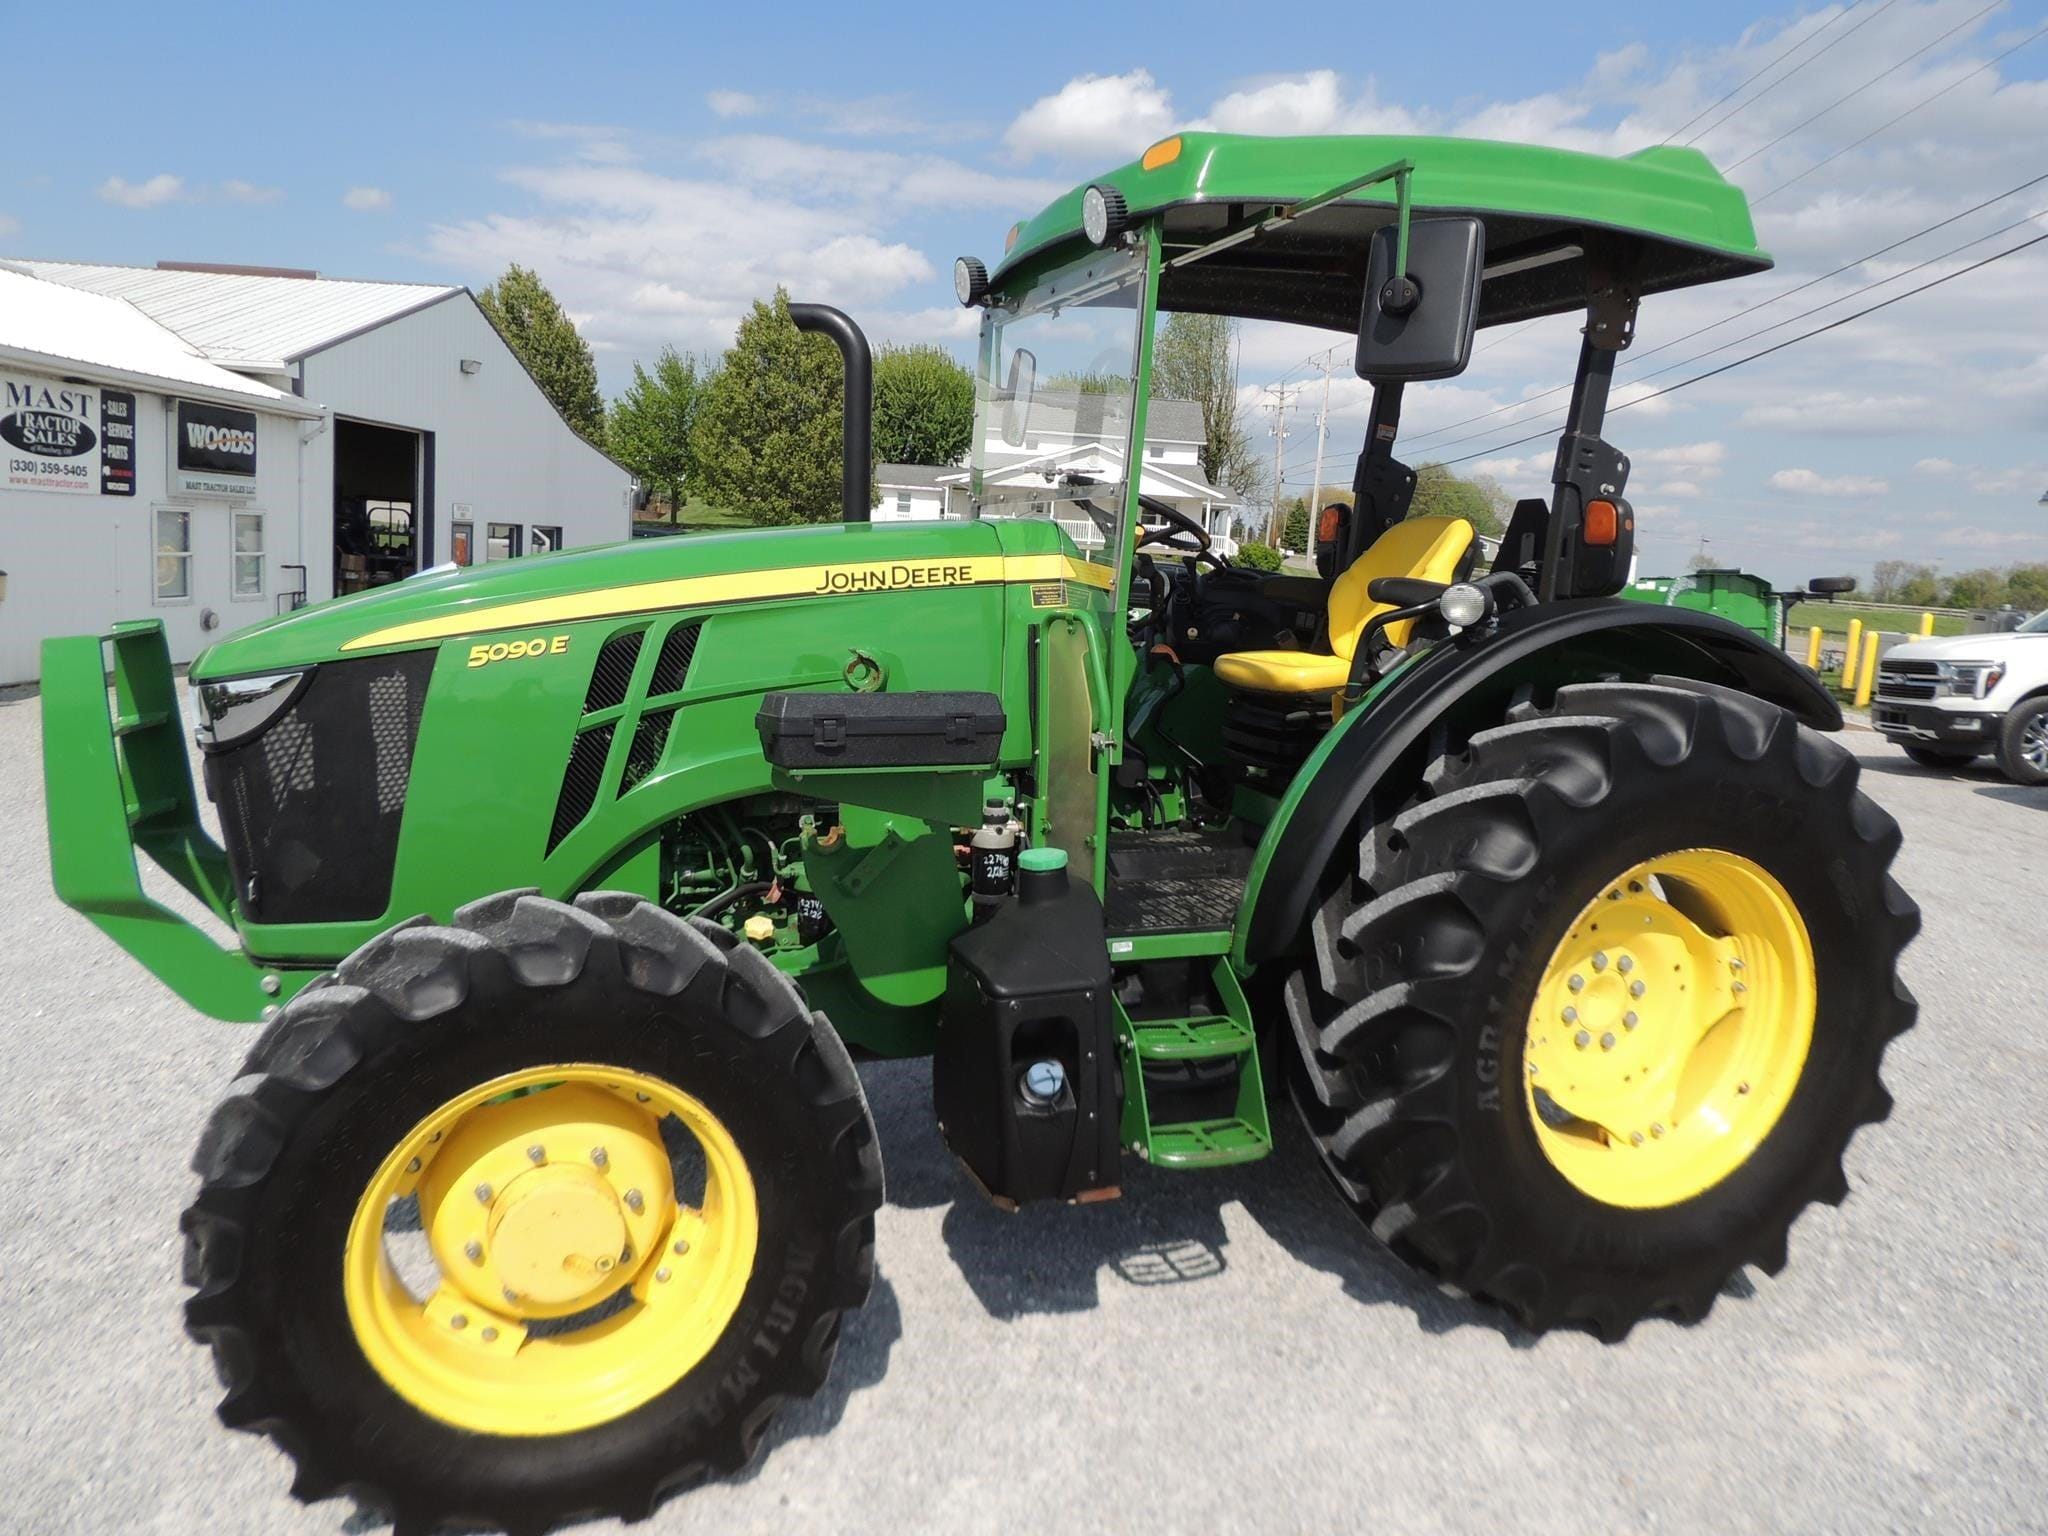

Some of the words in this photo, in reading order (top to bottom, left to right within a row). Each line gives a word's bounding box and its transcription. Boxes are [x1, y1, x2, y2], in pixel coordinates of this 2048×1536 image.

[6, 381, 93, 419] MAST
[107, 400, 127, 417] SALES
[15, 410, 82, 434] TRACTOR
[107, 422, 133, 439] SERVICE
[23, 428, 77, 447] SALES
[186, 422, 255, 455] WOODS
[107, 444, 129, 460] PARTS
[9, 459, 38, 475] (330)
[40, 462, 88, 477] 359-5405
[816, 570, 886, 591] JOHN
[891, 566, 973, 586] DEERE
[467, 638, 547, 668] 5090
[550, 635, 570, 654] E
